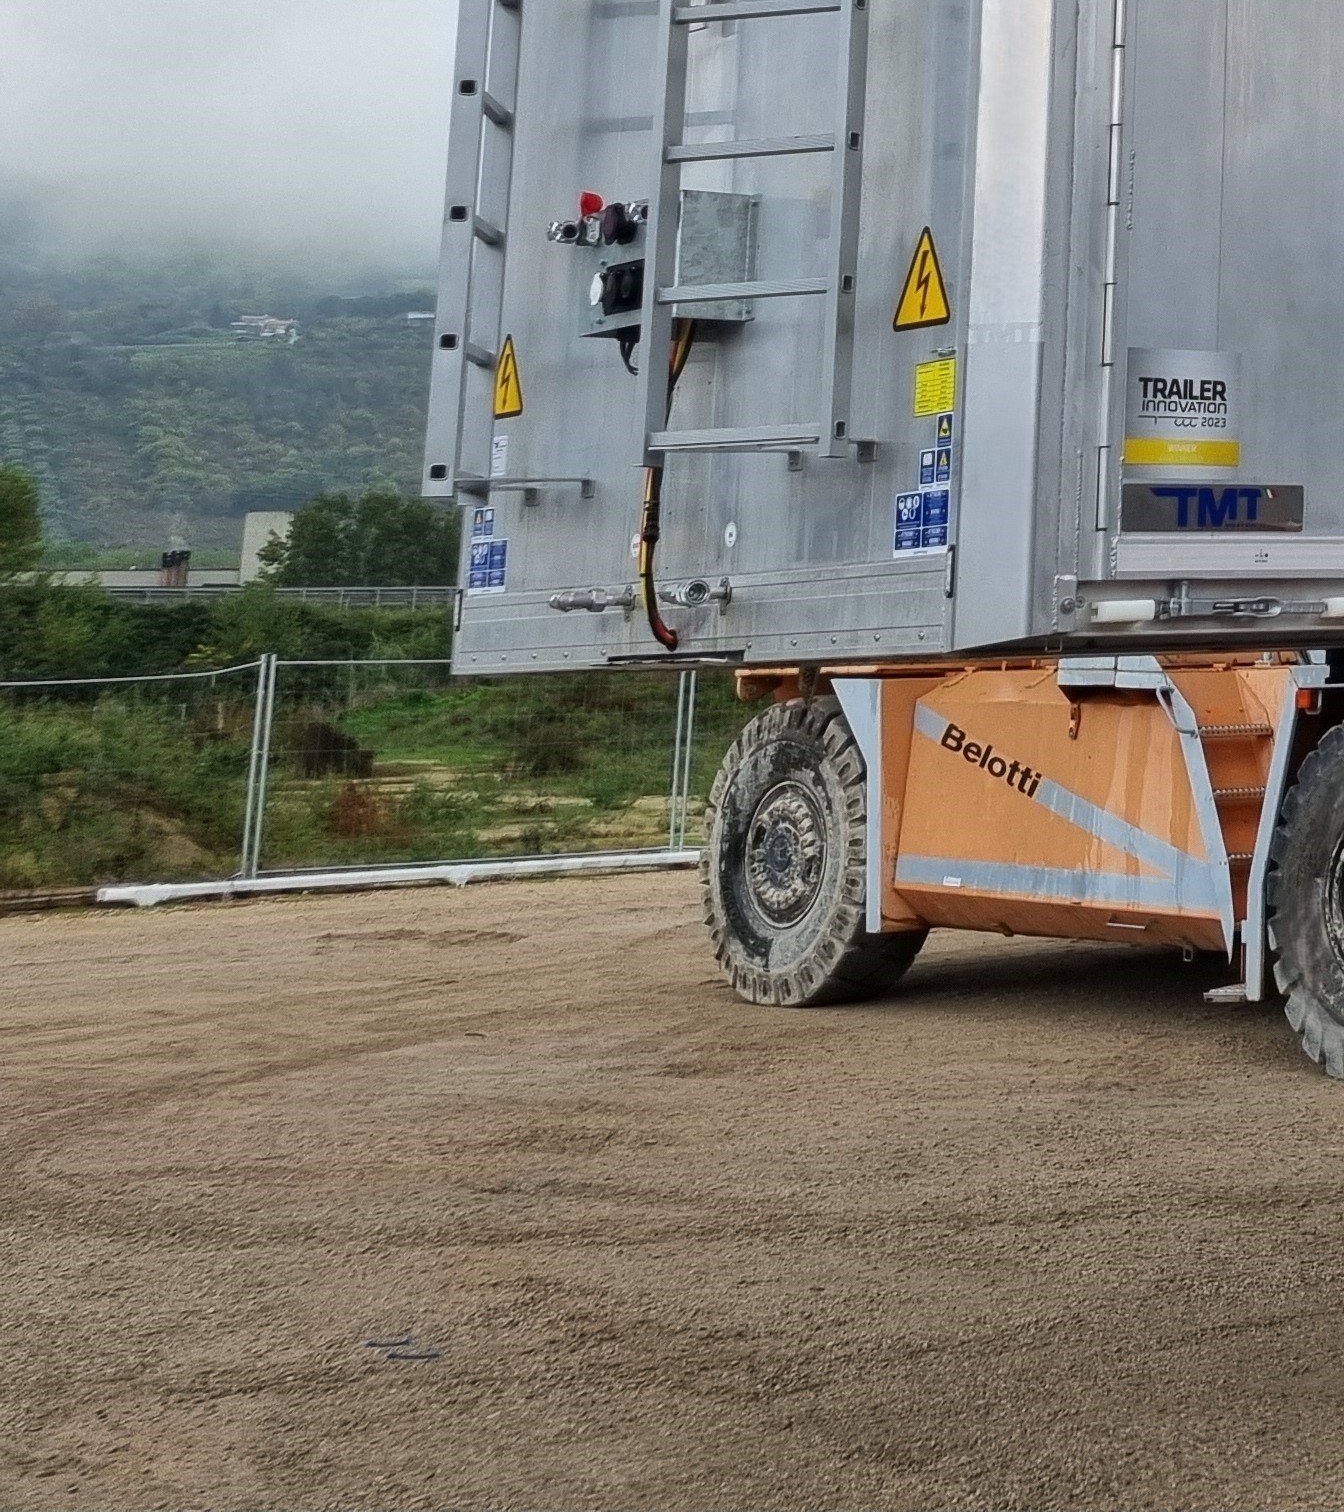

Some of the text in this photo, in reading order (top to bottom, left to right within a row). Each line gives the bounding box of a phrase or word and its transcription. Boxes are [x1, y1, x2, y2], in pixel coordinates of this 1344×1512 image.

[1138, 376, 1227, 402] TRAILER
[1201, 416, 1227, 428] 2023
[1150, 487, 1263, 528] TMT
[941, 723, 1042, 798] Belotti
